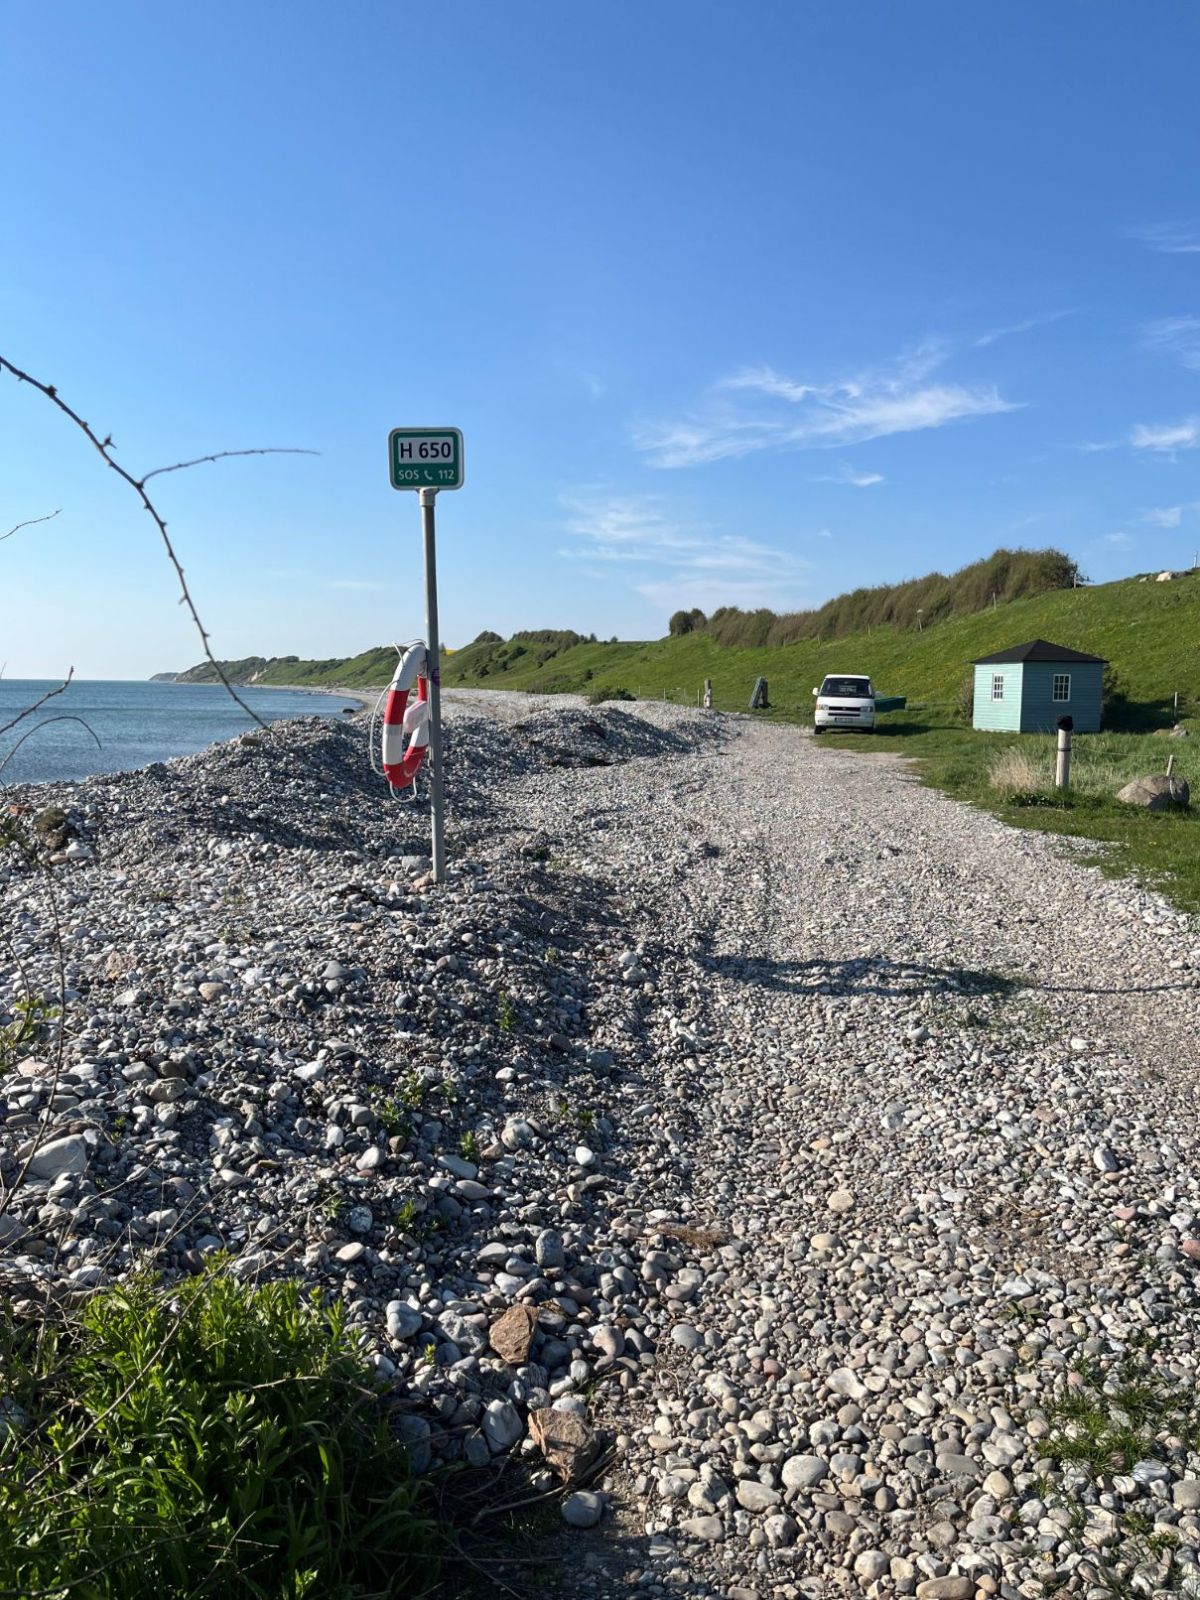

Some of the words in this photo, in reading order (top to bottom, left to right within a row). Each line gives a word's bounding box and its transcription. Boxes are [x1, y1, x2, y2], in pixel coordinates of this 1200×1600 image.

[400, 442, 412, 459] H
[419, 442, 451, 459] 650
[398, 469, 420, 480] SOS
[438, 469, 455, 480] 112
